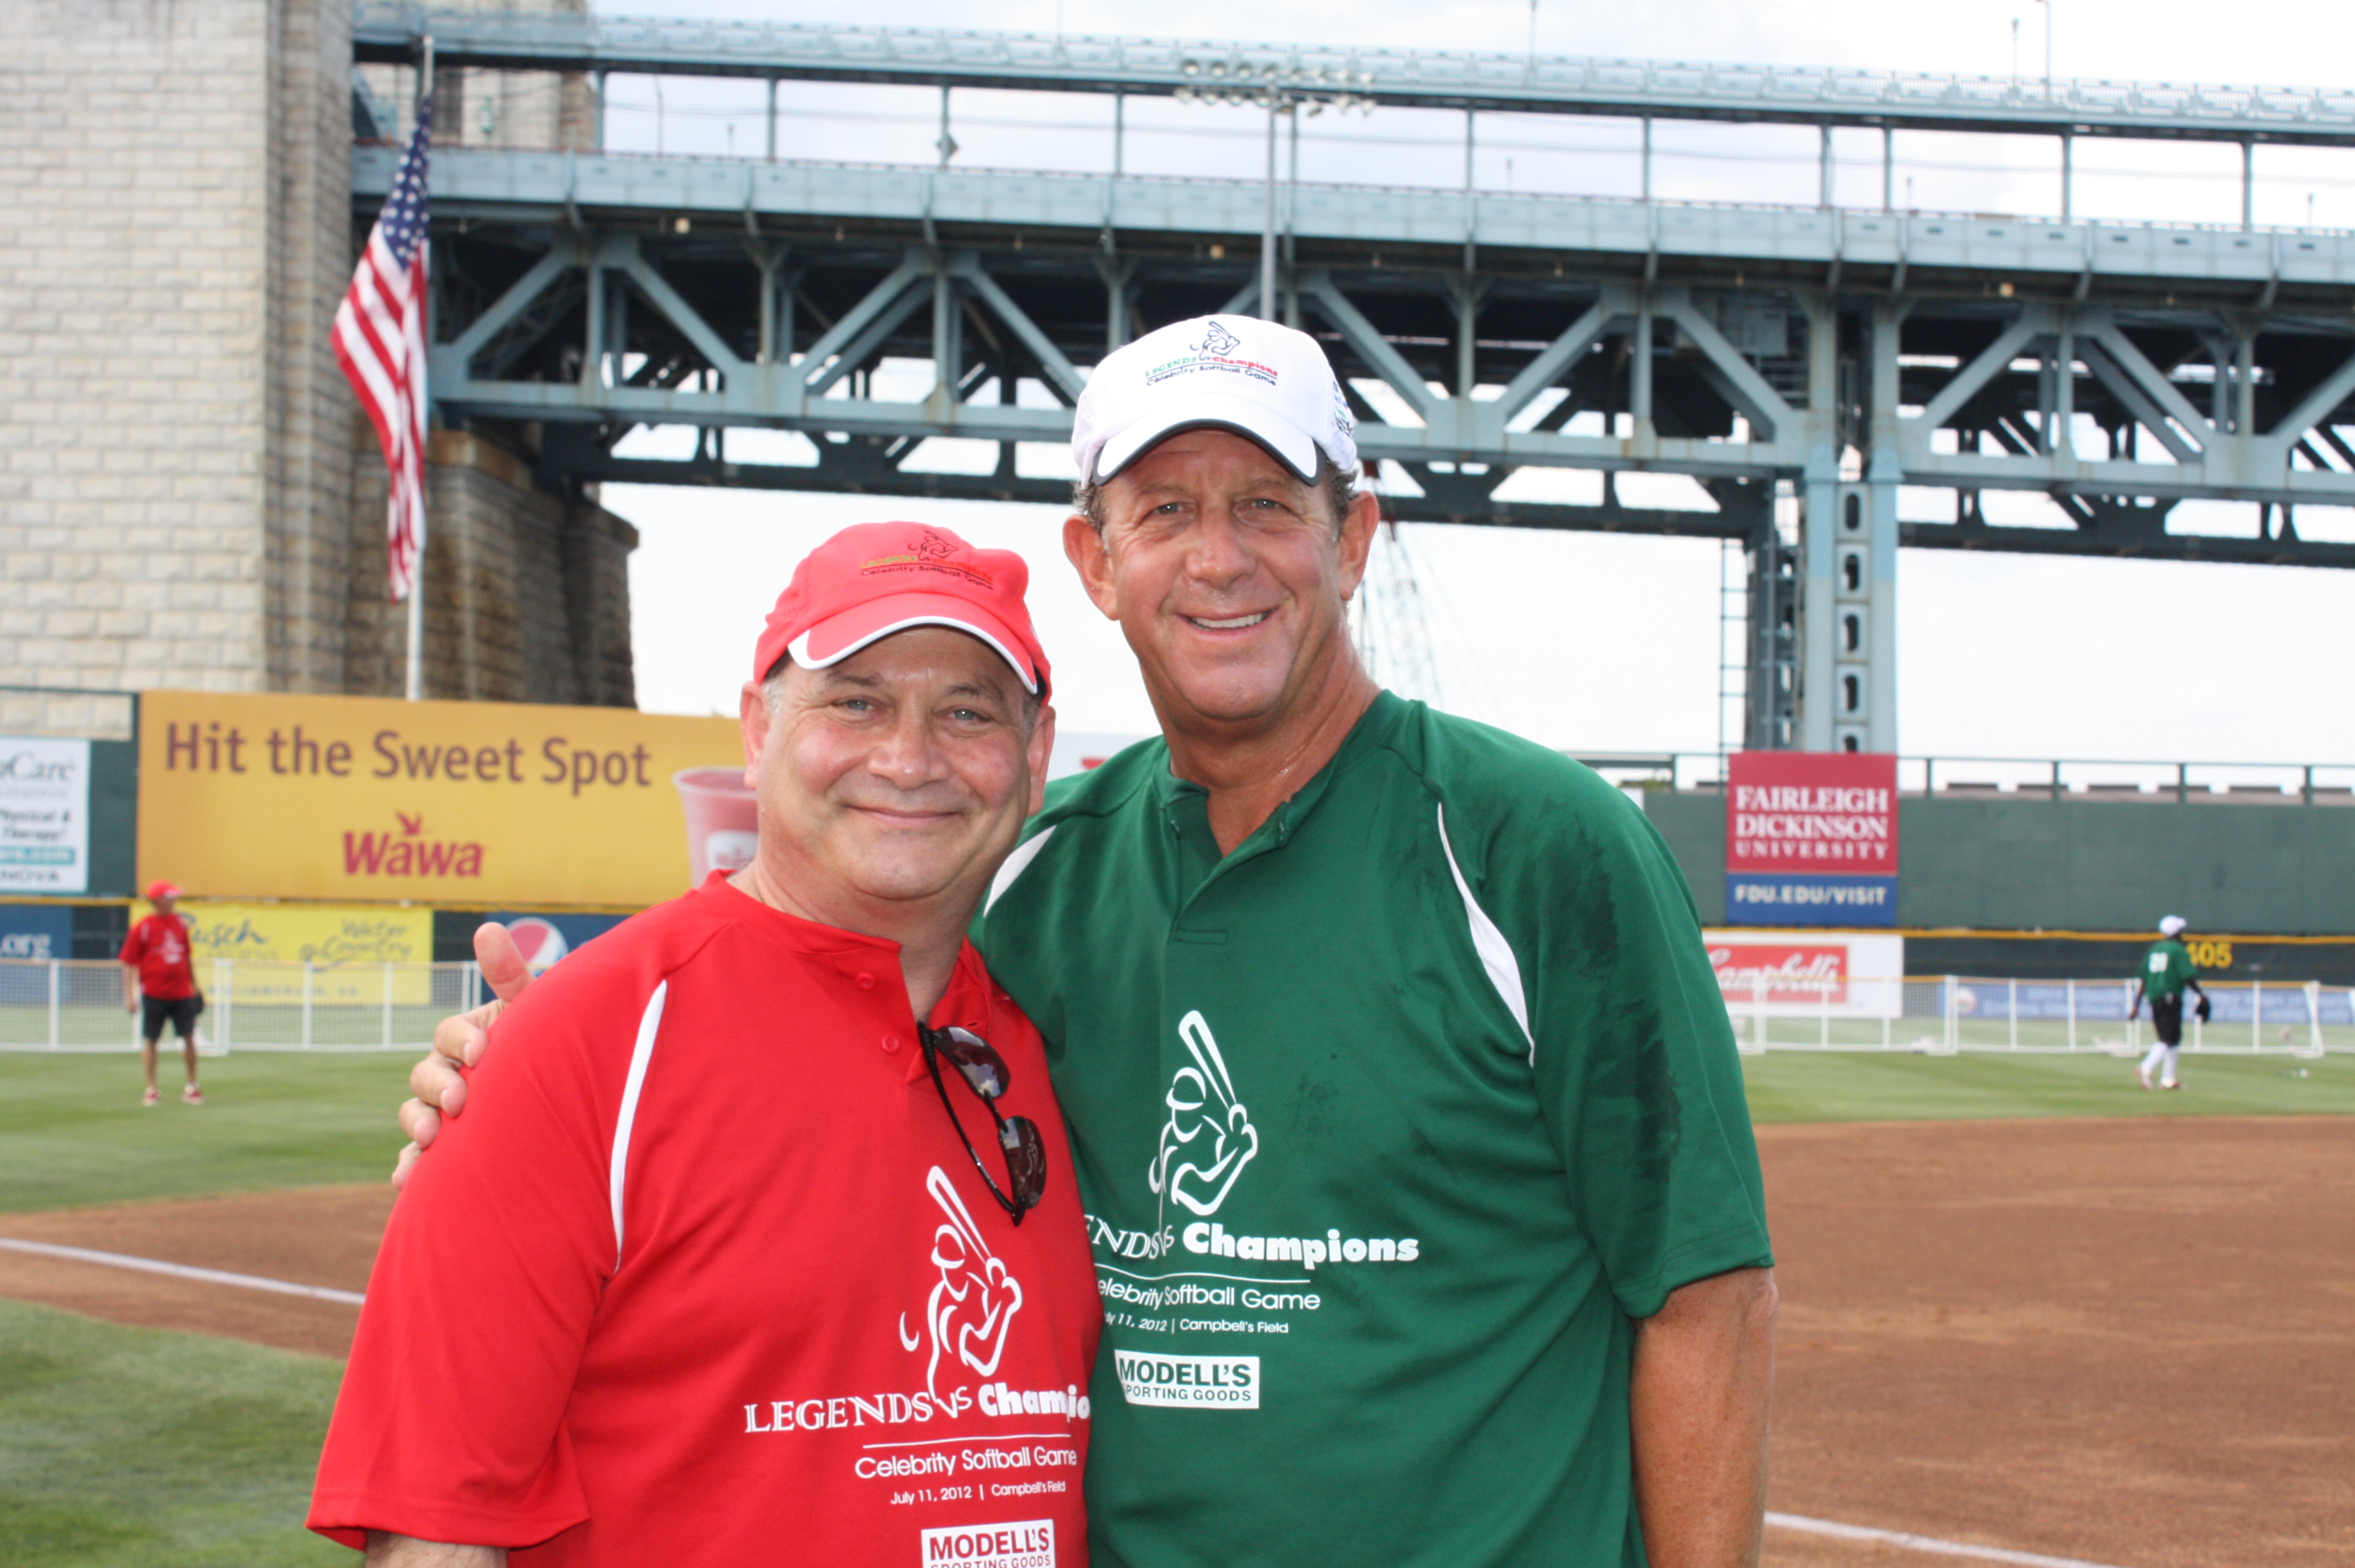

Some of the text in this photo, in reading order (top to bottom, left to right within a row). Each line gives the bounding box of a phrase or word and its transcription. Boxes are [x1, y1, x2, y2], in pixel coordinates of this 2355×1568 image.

[1146, 365, 1277, 386] Celebrity Softball Game
[1213, 356, 1278, 377] Champions
[861, 565, 915, 576] Celebrity
[919, 565, 962, 578] Softball
[166, 721, 651, 796] Hit the Sweet Spot
[1735, 785, 1889, 813] FAIRLEIGH
[1735, 813, 1889, 840] DICKINSON
[342, 831, 484, 878] Wawa
[1735, 840, 1889, 860] UNIVERSITY
[1734, 884, 1888, 905] FDU.EDU/VISIT
[1183, 1222, 1419, 1270] Champions
[1098, 1277, 1321, 1311] elebrity Softball Game
[1118, 1313, 1136, 1328] 11,
[1138, 1318, 1168, 1332] 2012
[1180, 1318, 1255, 1333] Campbell's
[1258, 1322, 1289, 1333] Field
[1119, 1358, 1251, 1387] MODELL'S
[1193, 1390, 1251, 1402] GOODS
[744, 1392, 933, 1433] LEGENDS
[855, 1446, 1077, 1479] Celebrity Softball Game
[890, 1481, 1066, 1505] July 11, 2012 Campbell's Field
[930, 1527, 1049, 1561] MODELL'S
[1011, 1554, 1051, 1568] GOODS
